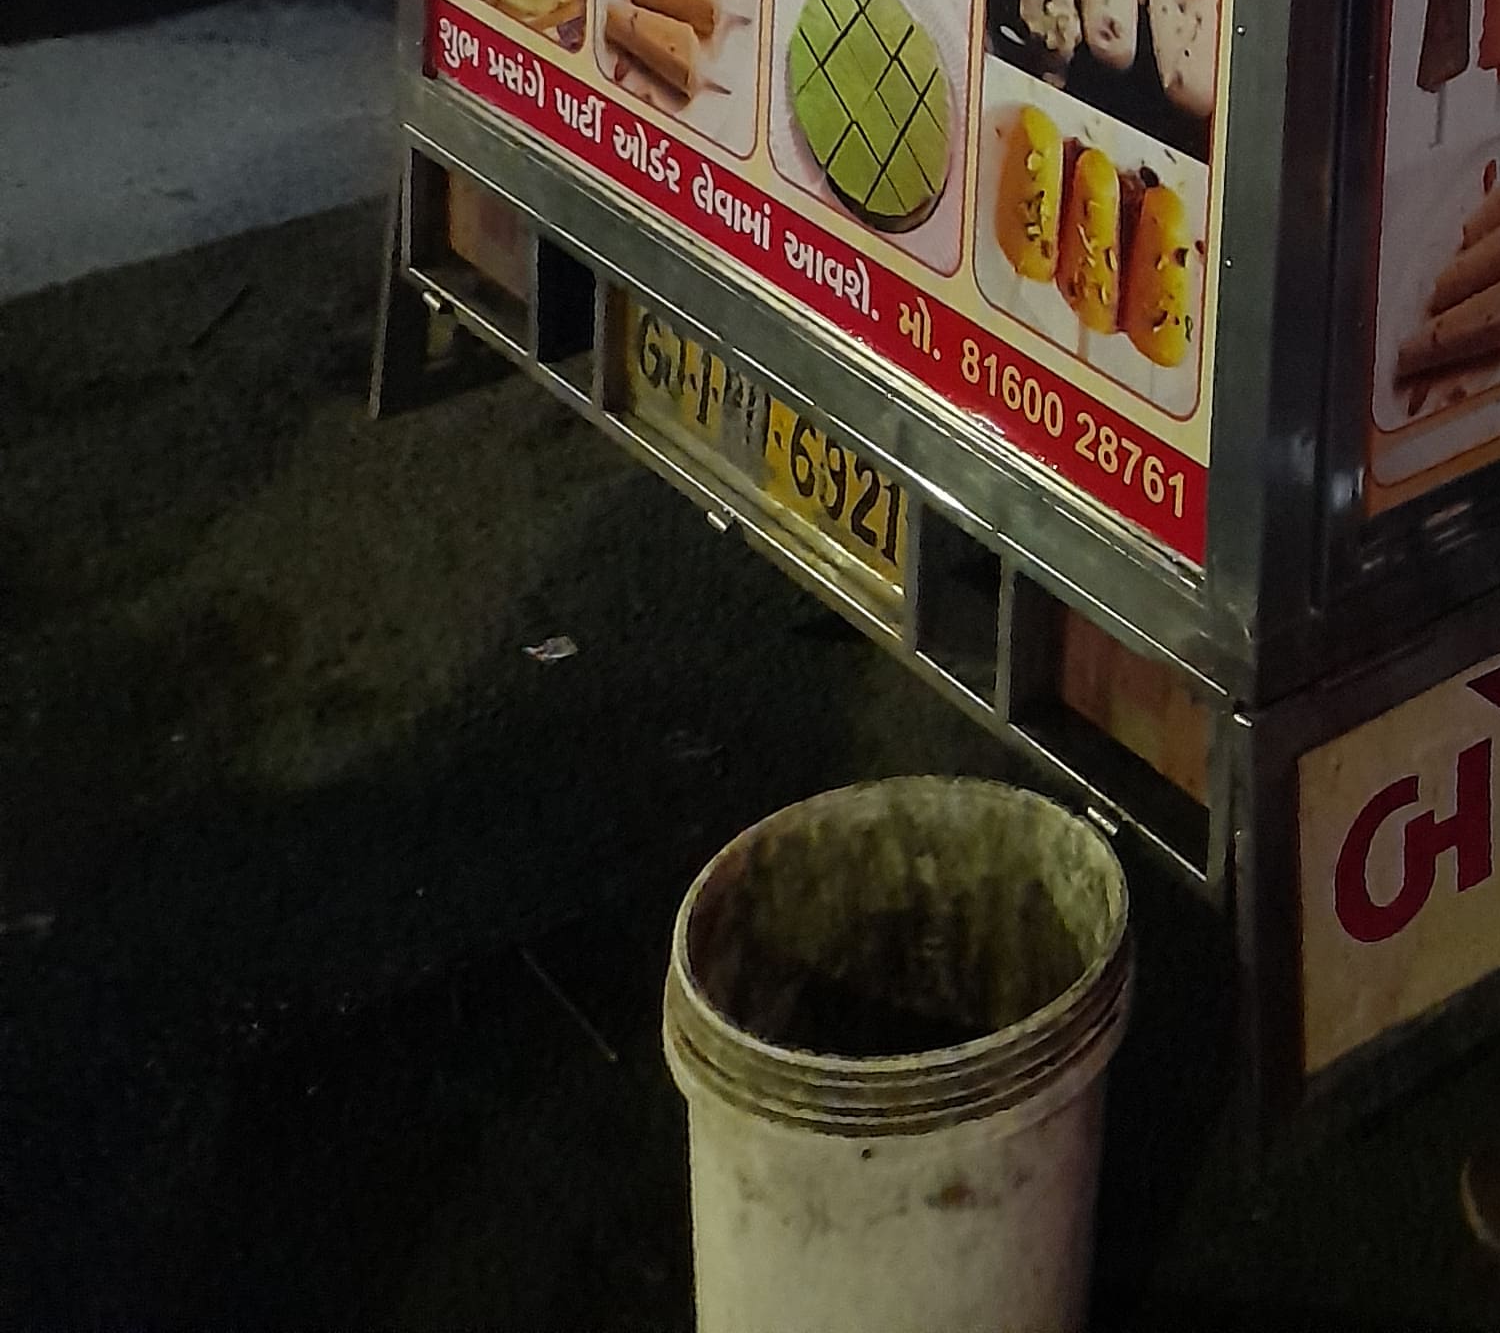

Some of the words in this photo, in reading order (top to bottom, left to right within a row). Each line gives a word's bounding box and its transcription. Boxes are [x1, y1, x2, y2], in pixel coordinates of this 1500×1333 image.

[439, 17, 478, 69] શુભ
[487, 46, 545, 108] પ્રસંગે
[555, 87, 606, 143] પાર્ટી
[613, 122, 682, 195] ઓર્ડર
[692, 163, 772, 251] લેવામાં
[961, 340, 1064, 438] 81600
[1075, 412, 1186, 518] 28761
